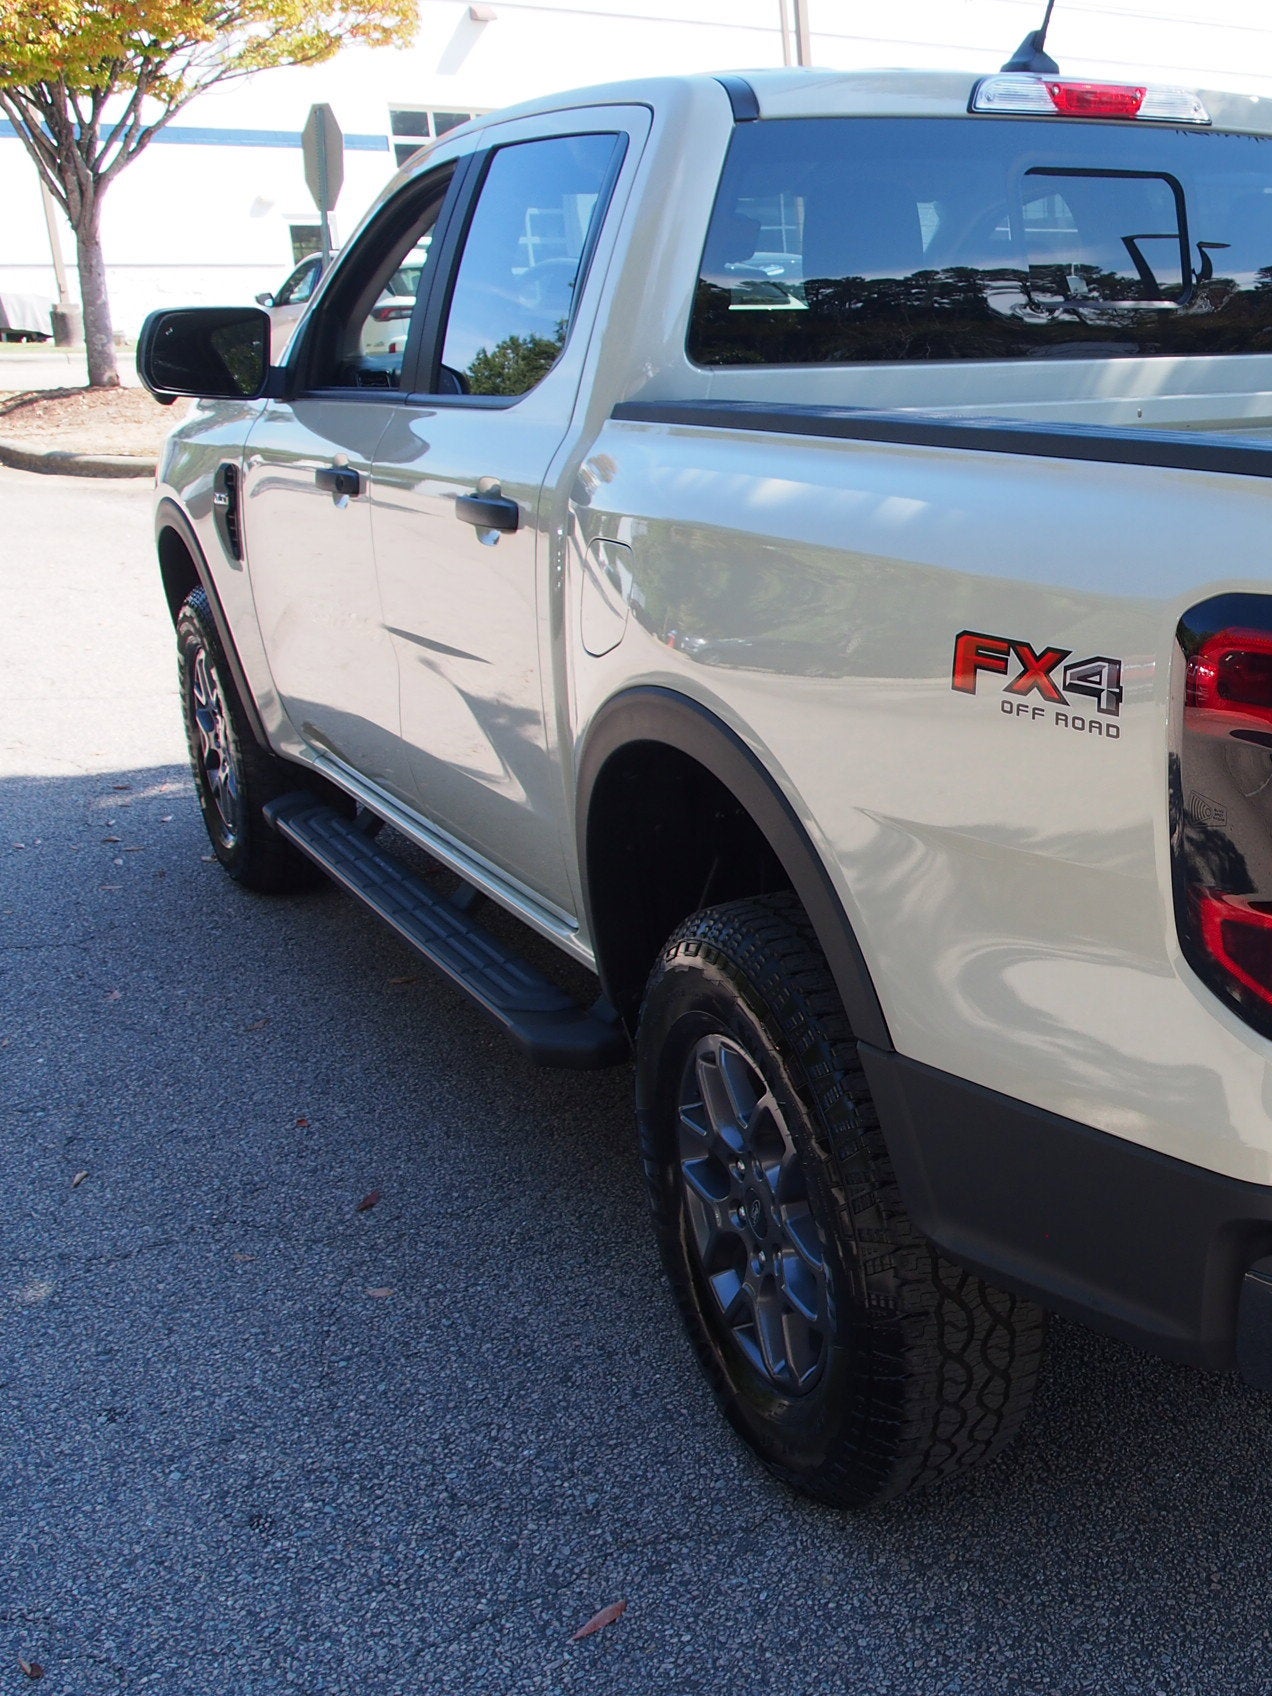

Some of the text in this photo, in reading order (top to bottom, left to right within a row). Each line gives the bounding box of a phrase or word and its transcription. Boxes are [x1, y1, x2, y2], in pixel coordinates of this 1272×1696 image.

[951, 630, 1123, 717] FX4
[1001, 700, 1120, 739] OFF ROAD
